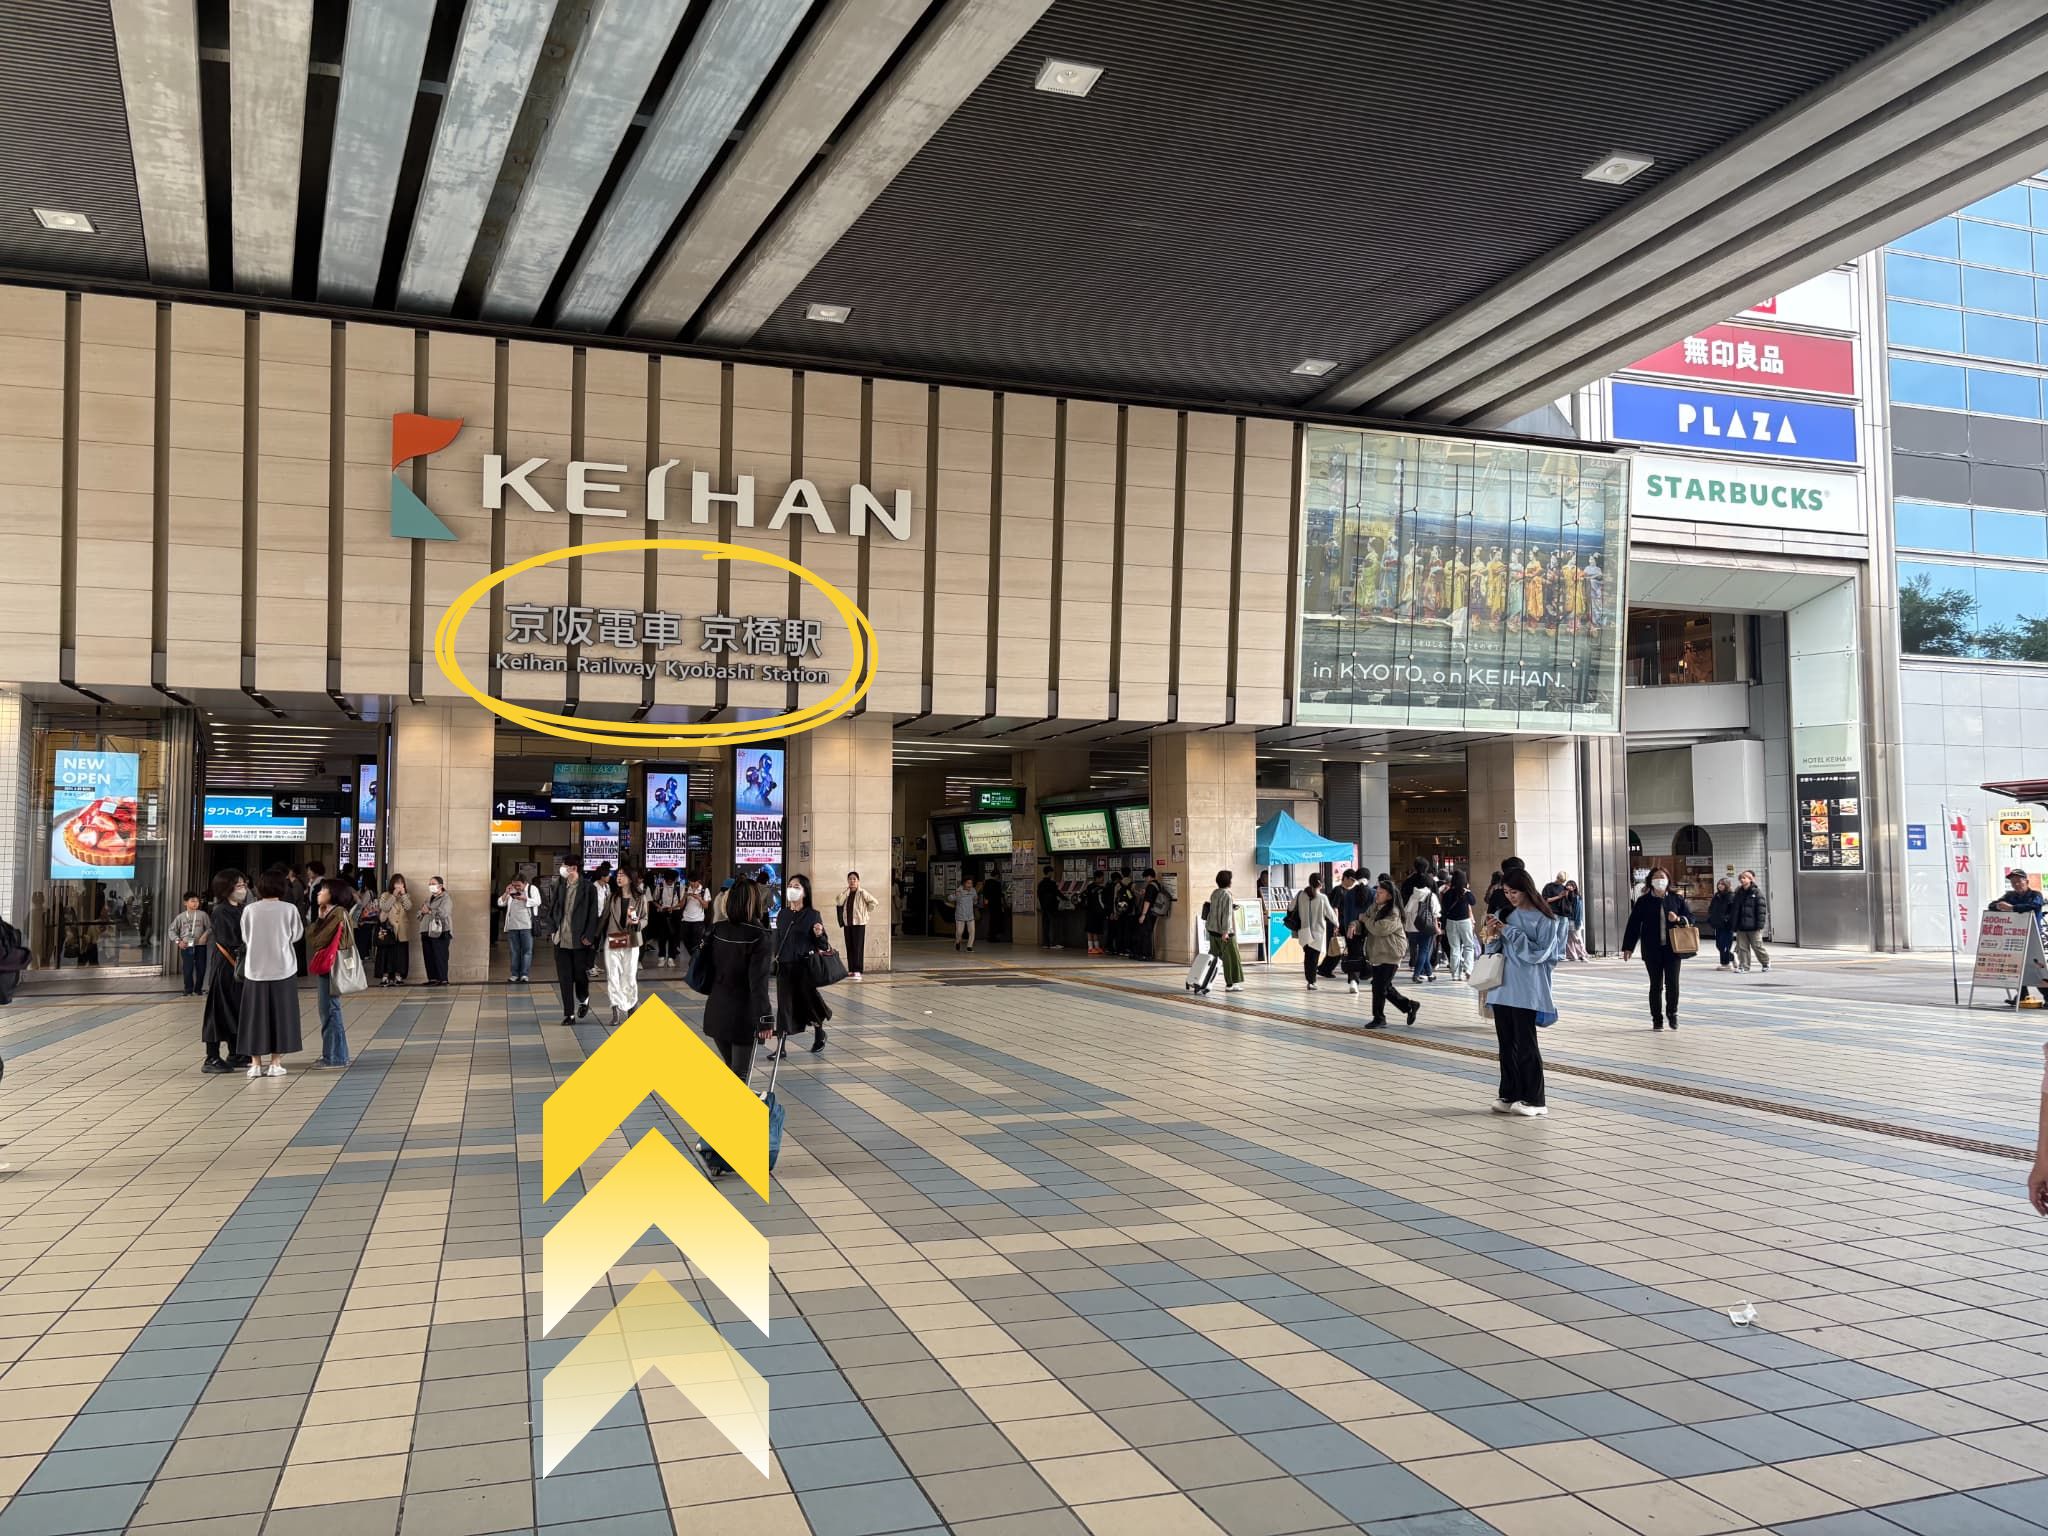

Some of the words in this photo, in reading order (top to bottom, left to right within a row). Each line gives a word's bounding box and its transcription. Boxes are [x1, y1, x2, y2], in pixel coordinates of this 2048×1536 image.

[1683, 336, 1784, 374] 無印良品
[1678, 403, 1797, 444] PLAZA
[482, 454, 912, 541] KEIHAN
[1646, 474, 1824, 511] STARBUCKS
[506, 602, 682, 650] 京阪電車
[700, 613, 822, 657] 京橋駅
[495, 653, 567, 672] Keihan
[577, 656, 656, 680] Railway
[665, 660, 756, 681] Kyobashi
[762, 665, 830, 683] Station
[1313, 661, 1332, 678] in
[1341, 663, 1426, 685] KYOTO,
[1433, 671, 1462, 684] on
[1469, 668, 1566, 688] KEIHAN.
[63, 757, 105, 769] NEW
[62, 772, 111, 785] OPEN
[736, 820, 783, 830] ULTRAMAN
[647, 832, 686, 840] ULTRAMAN
[736, 830, 782, 841] EXHIBITION
[584, 840, 618, 848] ULTRAMAN
[647, 840, 686, 849] EXHIBITION
[584, 847, 618, 855] EXHIBITION
[1983, 916, 2013, 924] 400mL
